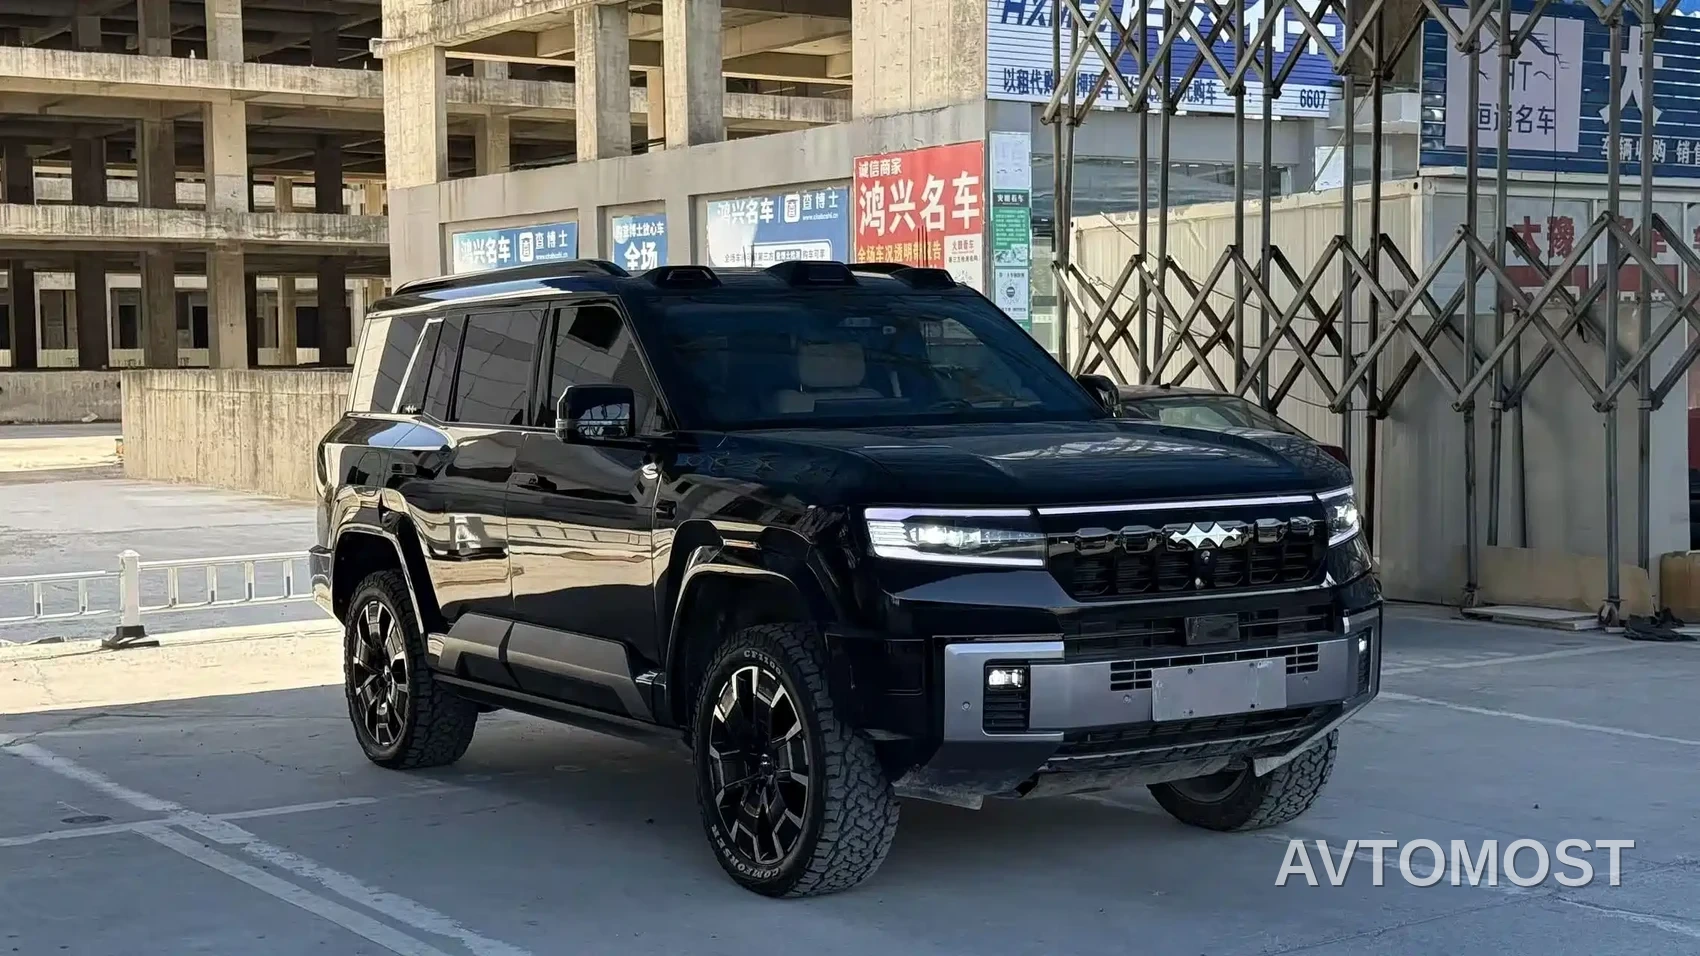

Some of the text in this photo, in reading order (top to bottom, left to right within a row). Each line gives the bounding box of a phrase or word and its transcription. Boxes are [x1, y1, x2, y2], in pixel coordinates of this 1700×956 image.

[1299, 88, 1327, 110] 6607
[858, 157, 902, 179] 诚信商家
[717, 197, 774, 224] 鸿兴名车
[859, 170, 980, 237] 鸿兴名车
[623, 240, 658, 270] 全场
